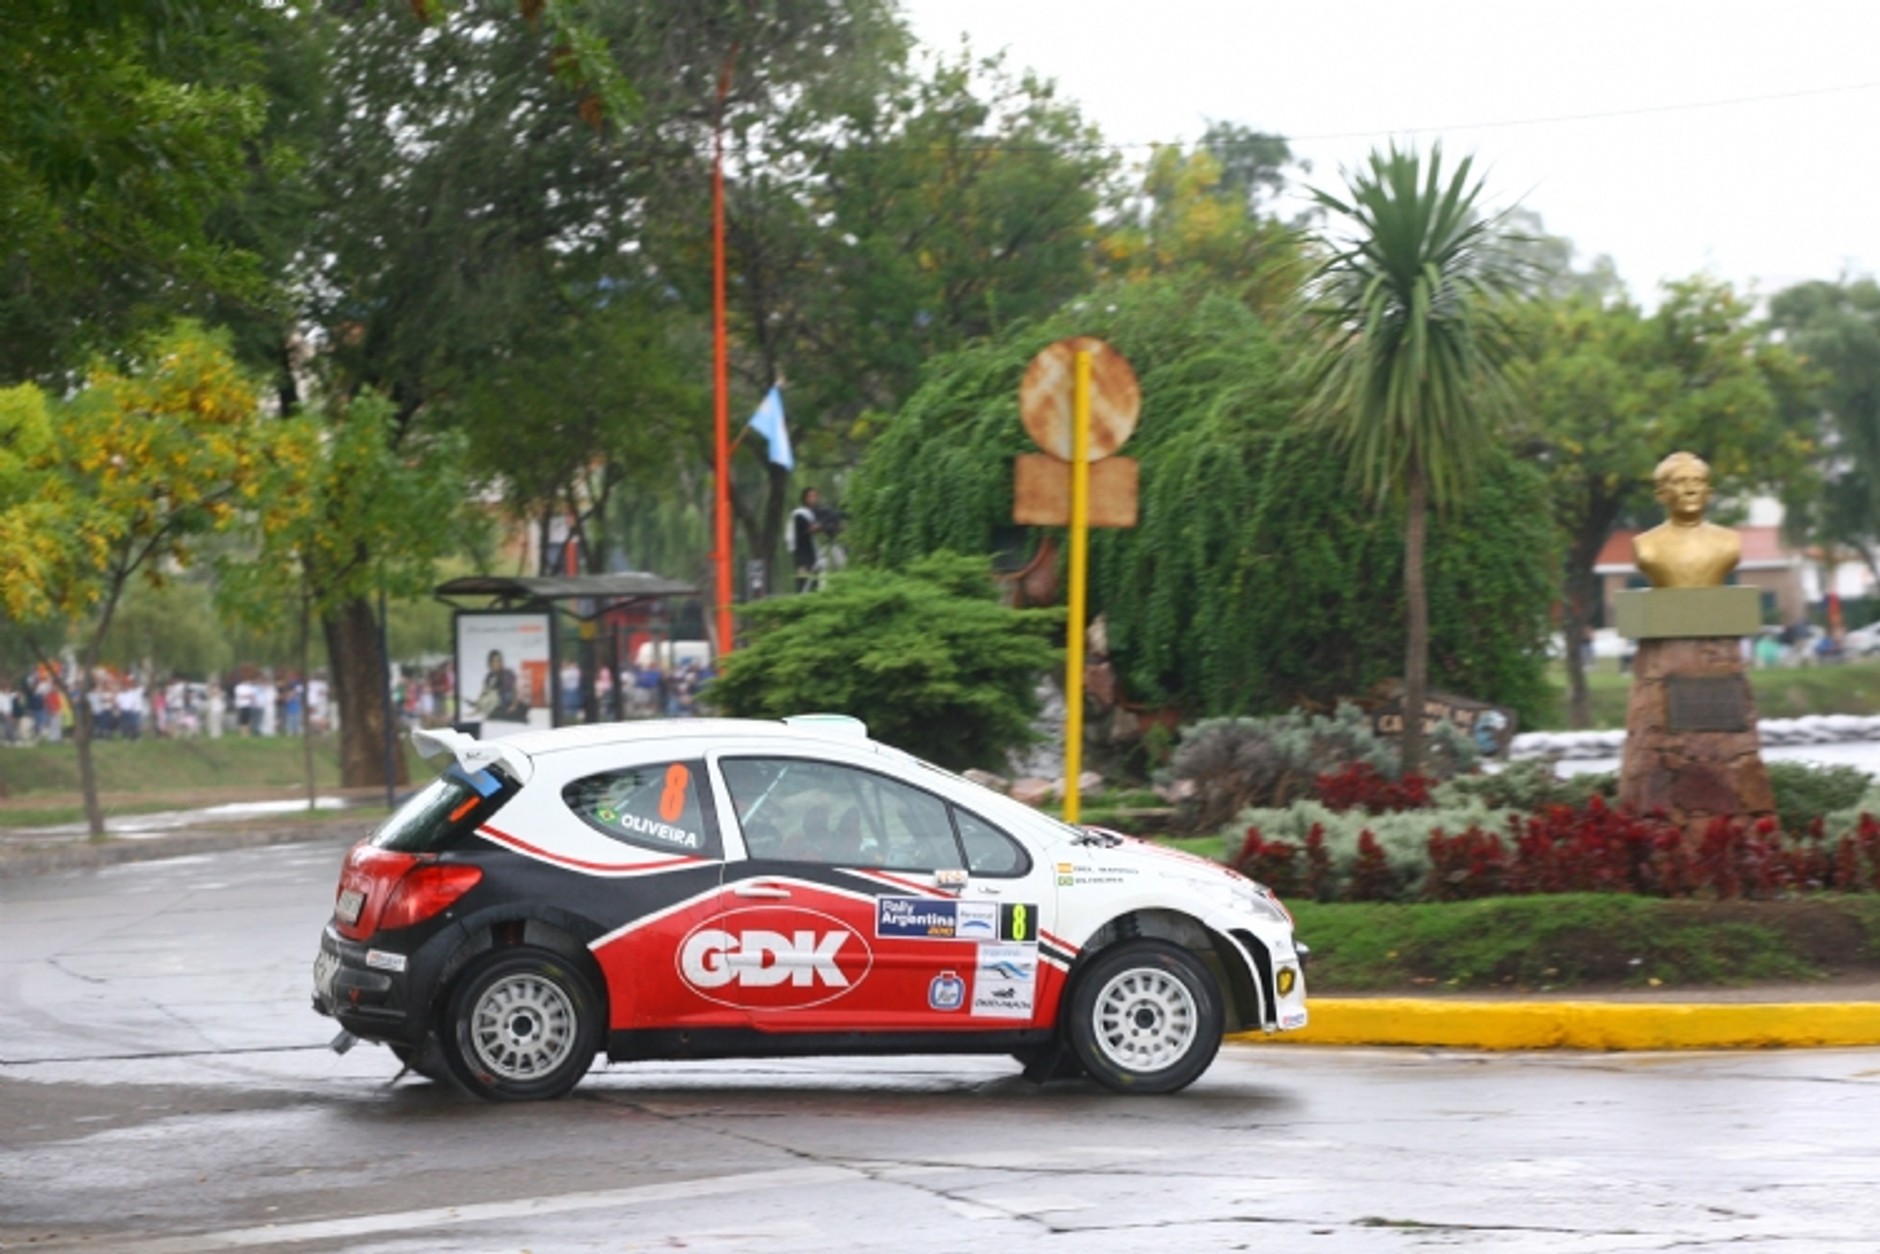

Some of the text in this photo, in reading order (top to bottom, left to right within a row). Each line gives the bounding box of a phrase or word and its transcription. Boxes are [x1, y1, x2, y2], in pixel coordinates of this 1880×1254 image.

[659, 763, 690, 823] 8
[620, 813, 698, 848] OLIVEIRA
[881, 900, 915, 915] Rally
[881, 911, 955, 928] Argentina
[1012, 903, 1026, 941] 8
[681, 928, 851, 988] GDK
